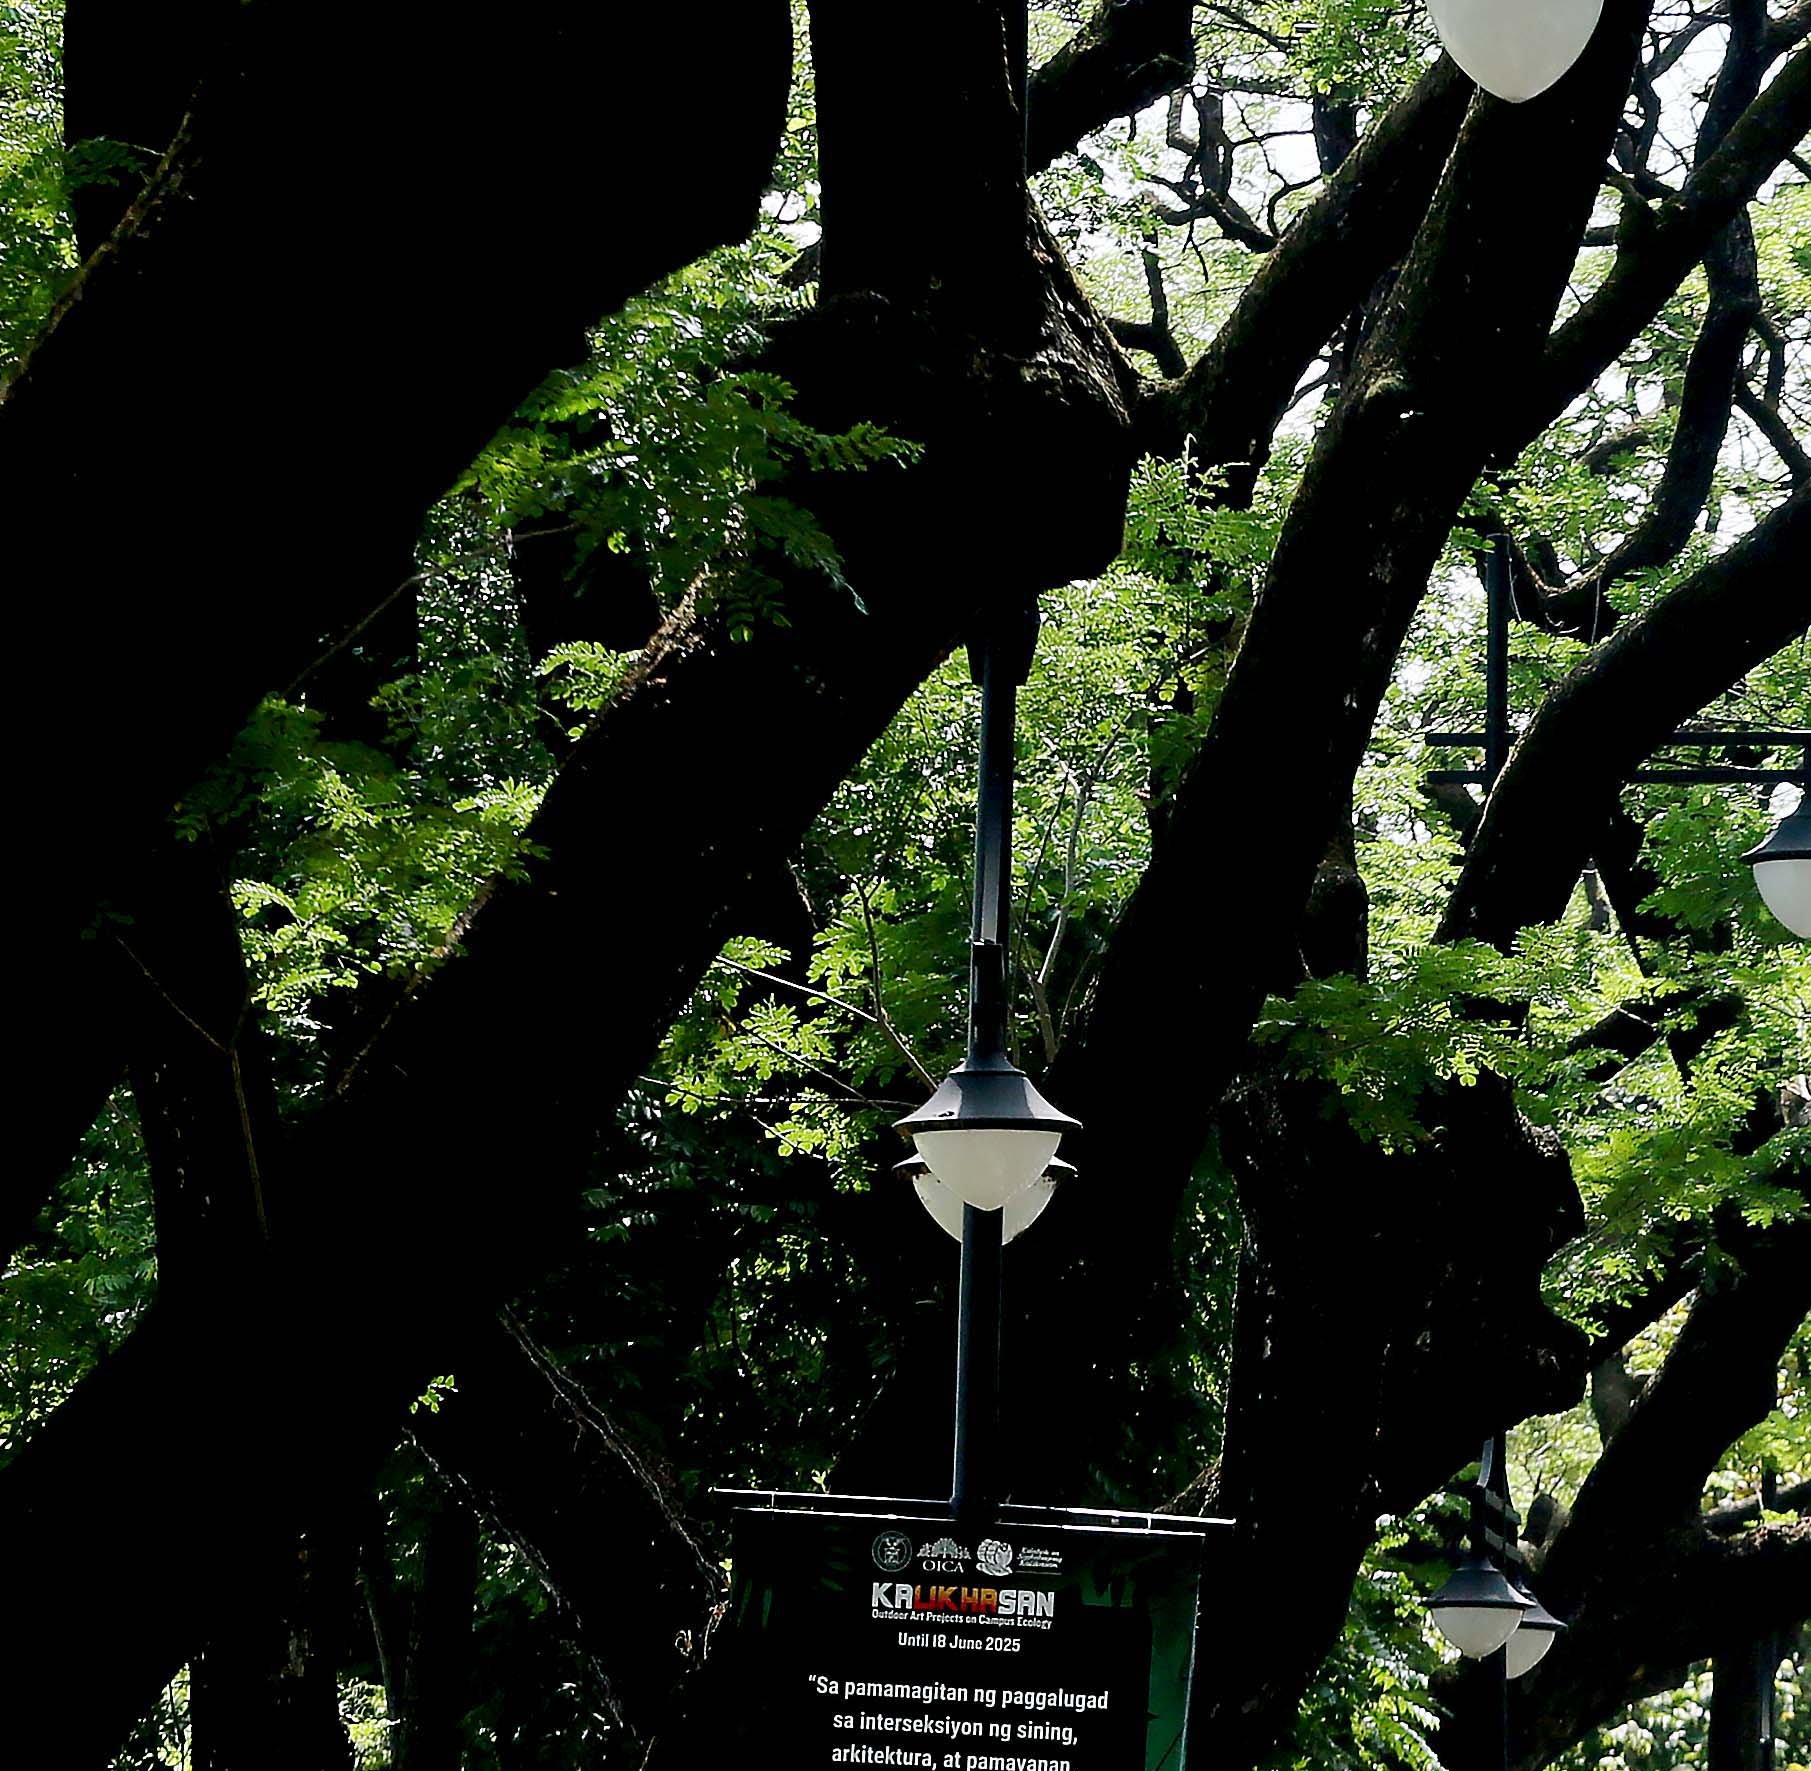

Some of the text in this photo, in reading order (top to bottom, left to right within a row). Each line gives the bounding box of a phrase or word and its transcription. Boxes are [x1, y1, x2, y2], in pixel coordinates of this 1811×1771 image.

[922, 1560, 965, 1574] OICA
[871, 1582, 1055, 1617] KALIKHASAN
[871, 1608, 1053, 1630] Outdoor Art Projects on Campus Ecology
[898, 1631, 1021, 1653] Until 18 June 2025
[844, 1681, 968, 1704] pamamagitan
[973, 1688, 997, 1708] ng
[1001, 1687, 1109, 1713] paggalugad
[832, 1711, 1078, 1746] sa interseksiyon ng sining,
[831, 1743, 937, 1771] arkitektura,
[943, 1751, 962, 1769] at
